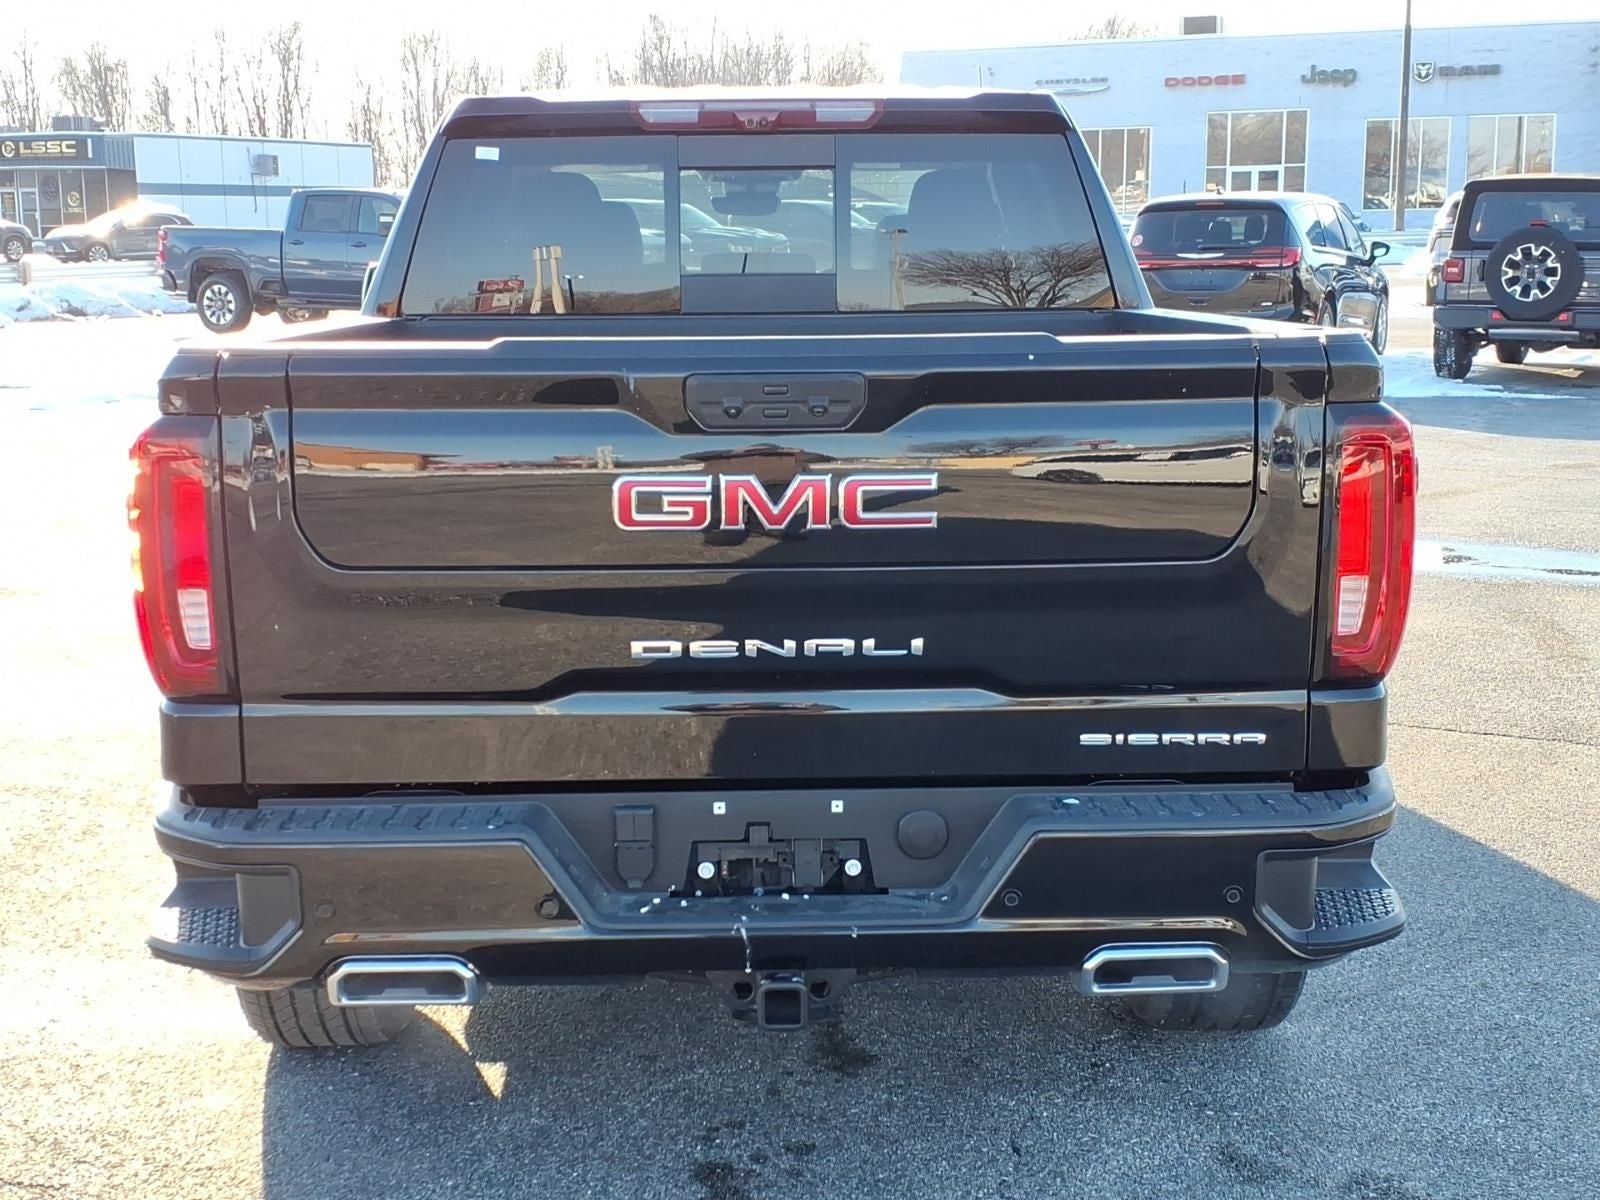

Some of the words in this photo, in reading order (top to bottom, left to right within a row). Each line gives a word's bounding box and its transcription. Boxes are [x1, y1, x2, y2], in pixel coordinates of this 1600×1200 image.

[1164, 74, 1246, 87] DODGE
[1301, 65, 1357, 87] Jeep
[19, 141, 76, 154] LSSC
[612, 473, 938, 531] GMC
[630, 638, 924, 658] DENALI
[1079, 732, 1267, 746] SIERRA
